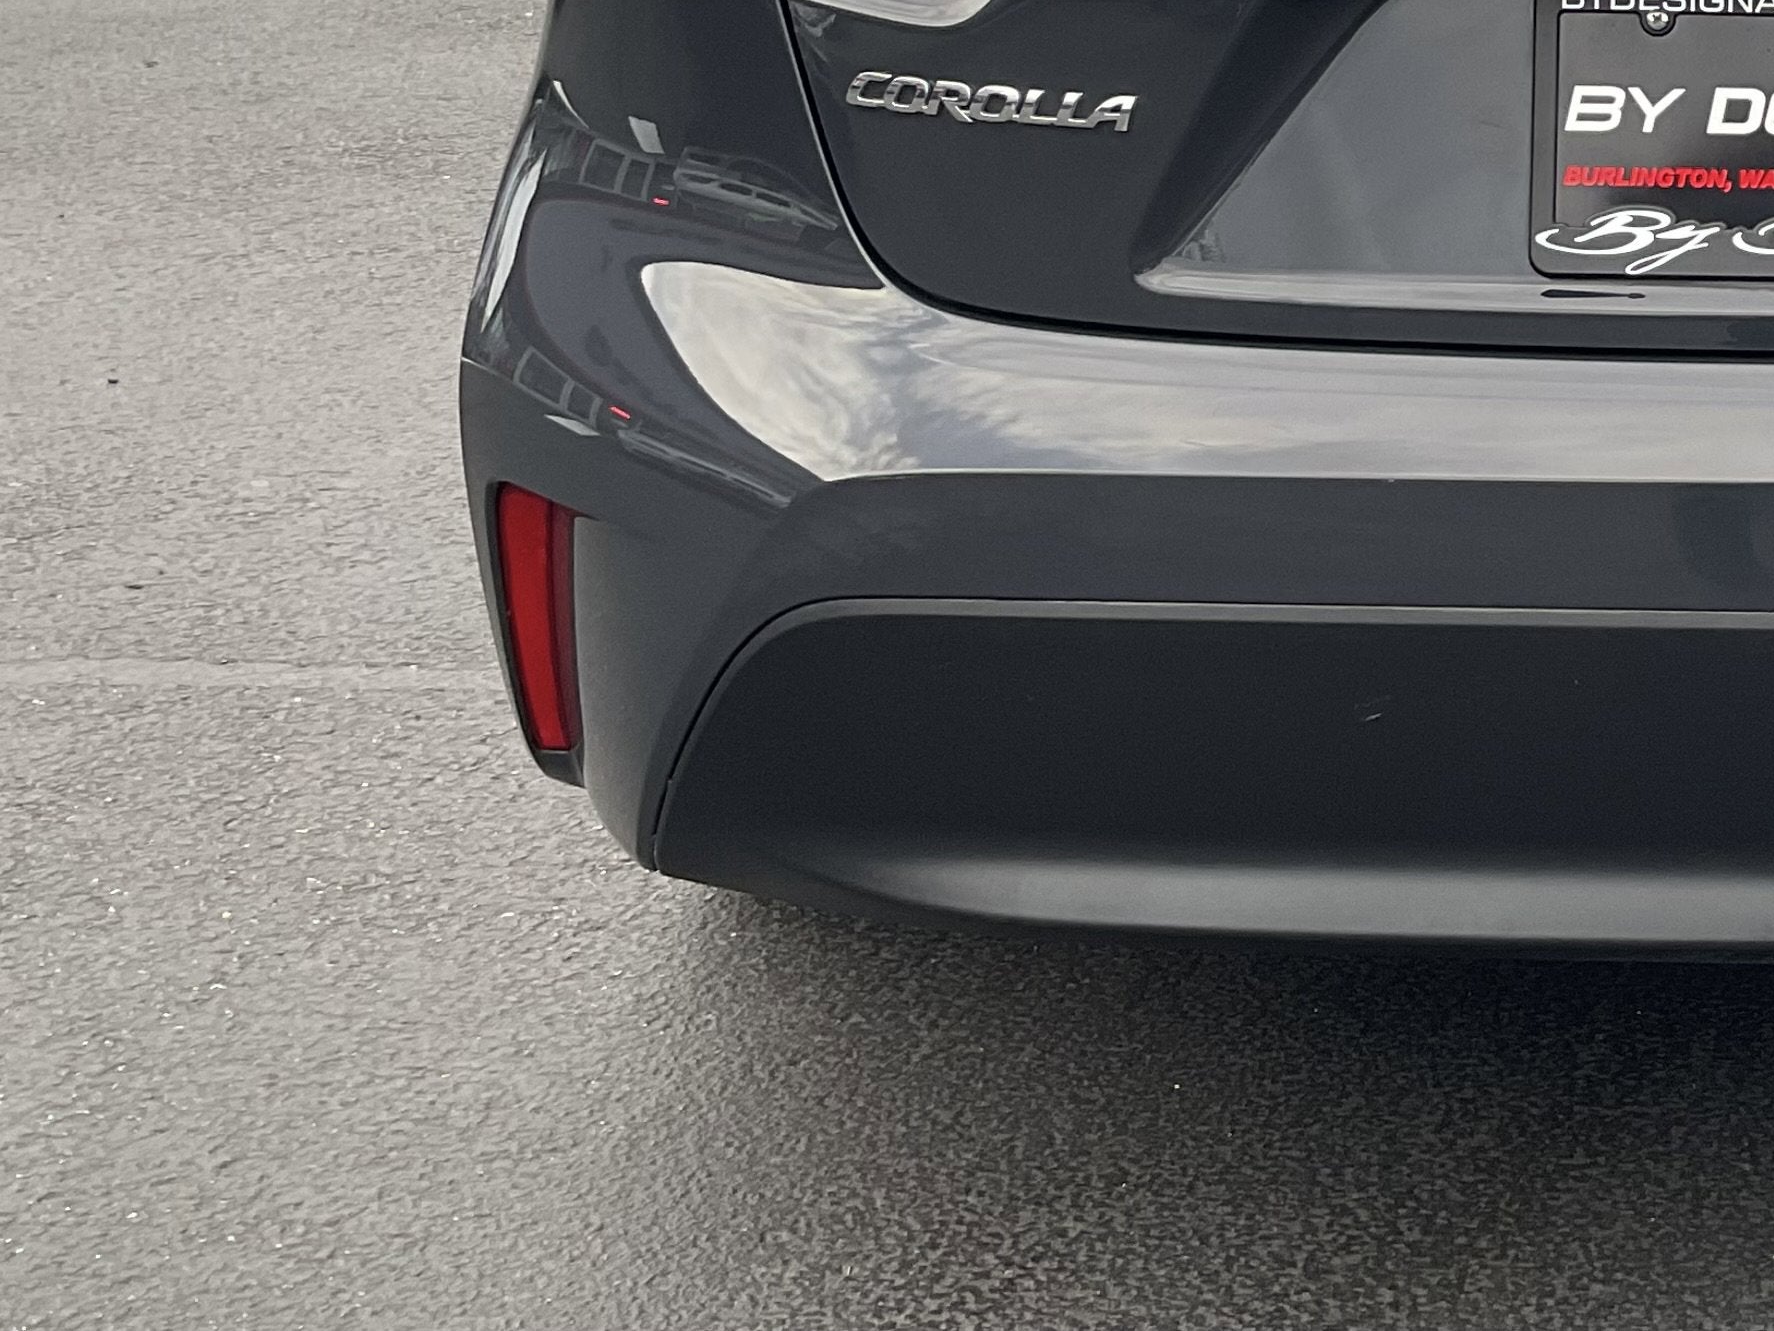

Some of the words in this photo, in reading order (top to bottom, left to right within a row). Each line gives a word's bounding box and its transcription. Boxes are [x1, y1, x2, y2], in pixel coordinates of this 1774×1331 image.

[846, 71, 1138, 132] COROLLA
[1564, 85, 1686, 133] BY
[1562, 165, 1733, 193] BURLINGTON,
[1535, 210, 1721, 275] By
